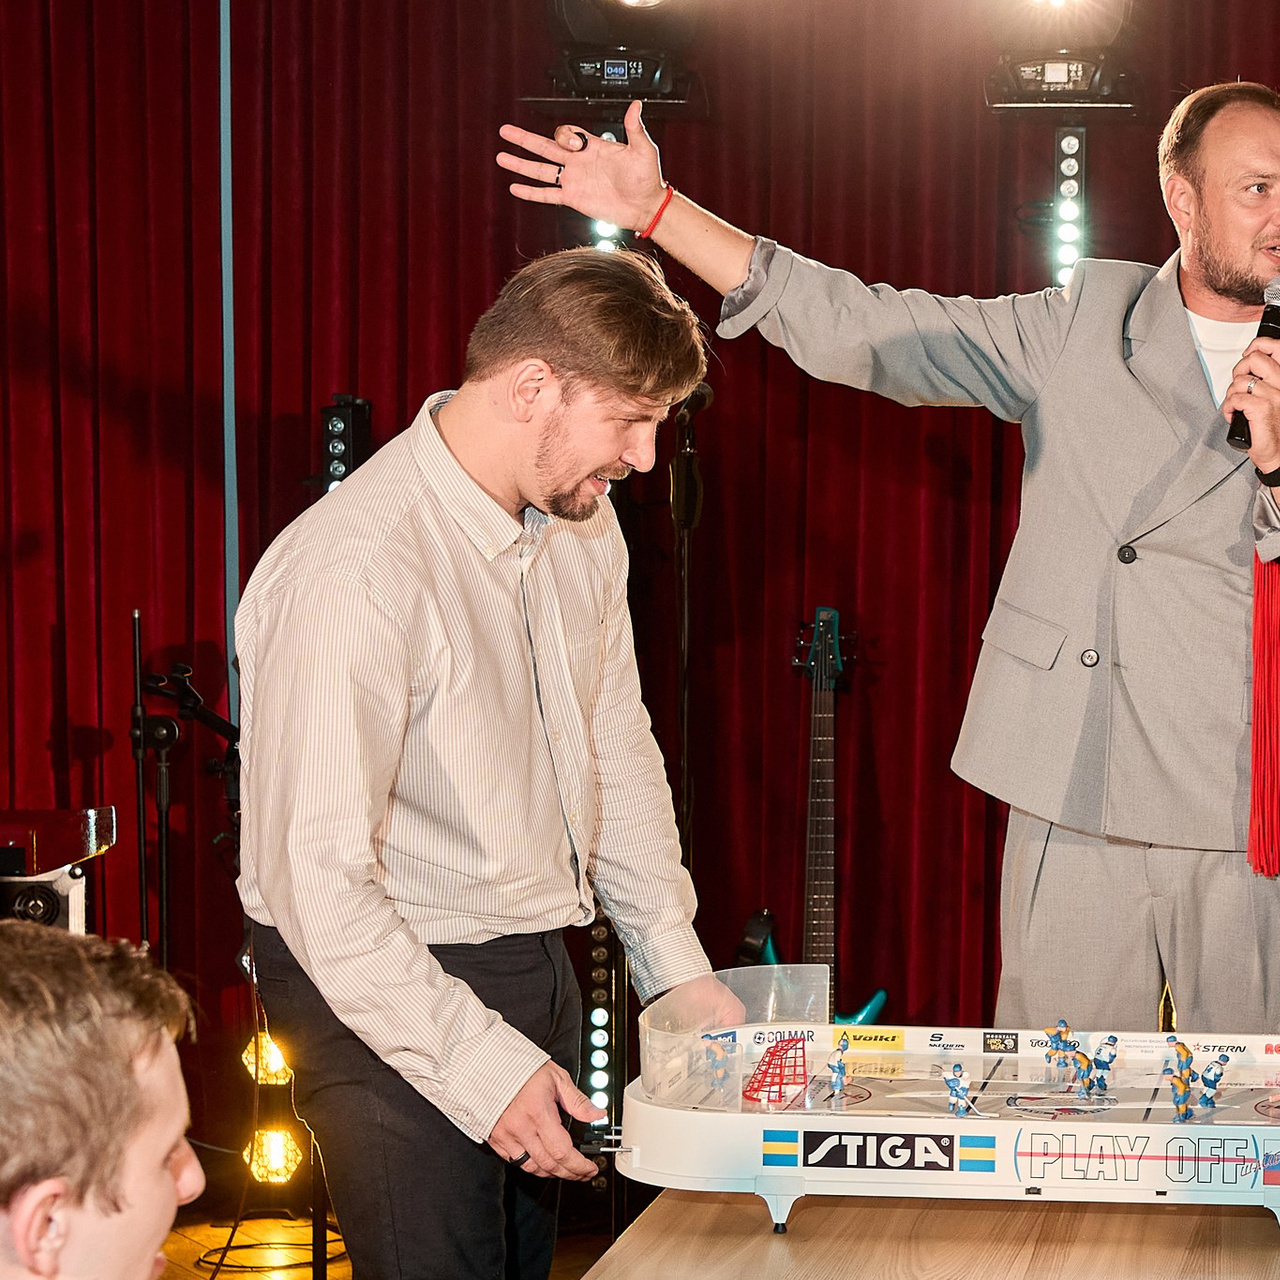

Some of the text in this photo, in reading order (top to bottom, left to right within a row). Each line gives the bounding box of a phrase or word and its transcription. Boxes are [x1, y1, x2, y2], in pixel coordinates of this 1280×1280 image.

[607, 66, 625, 75] 049
[767, 1030, 815, 1043] COLMAR
[1201, 1045, 1247, 1053] STERN
[807, 1134, 950, 1168] STIGA
[1030, 1132, 1249, 1185] PLAY OFF
